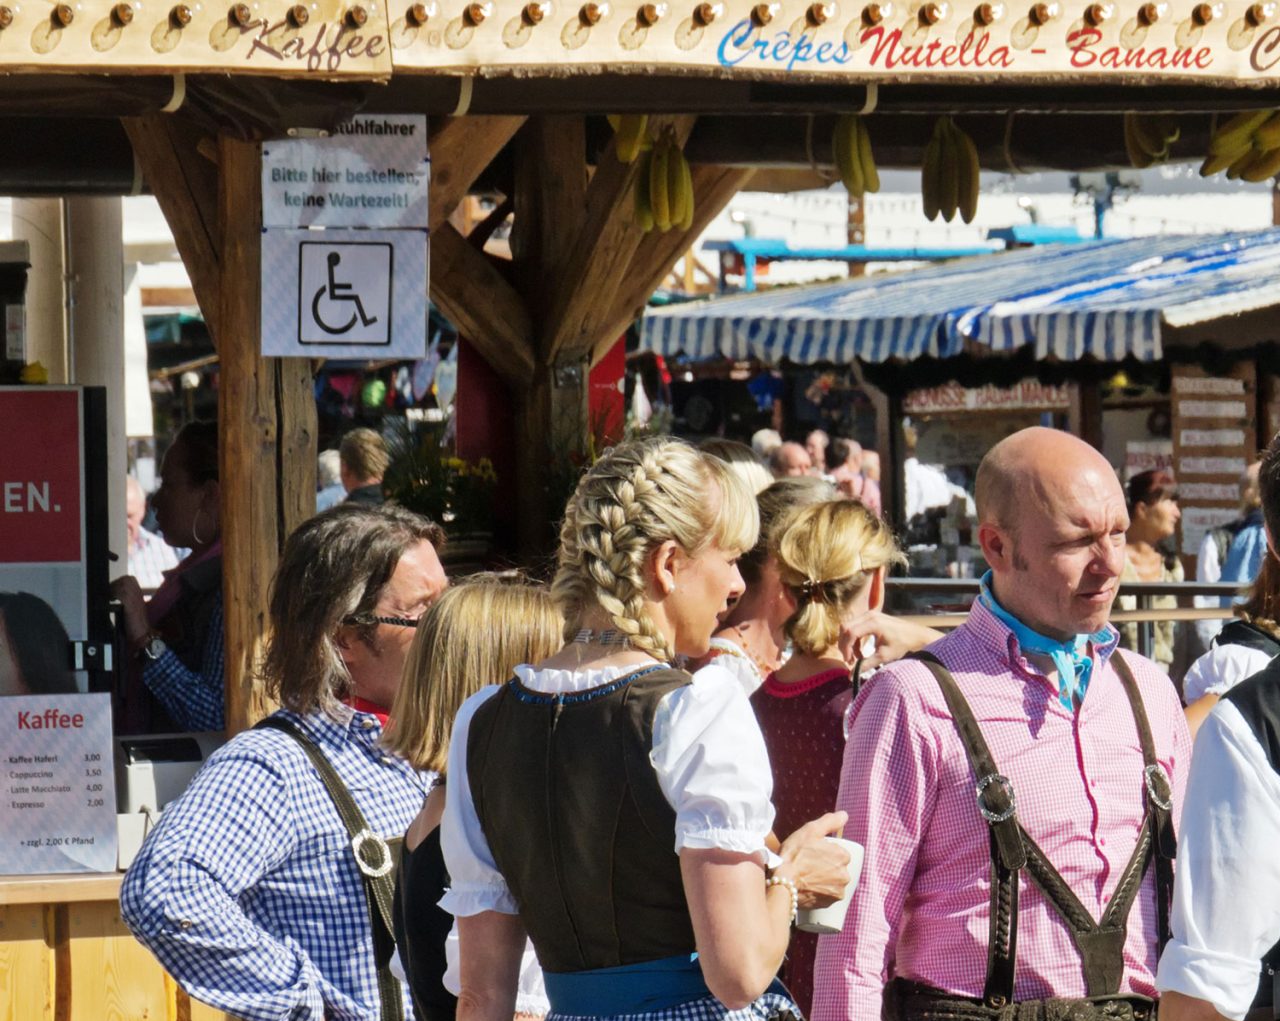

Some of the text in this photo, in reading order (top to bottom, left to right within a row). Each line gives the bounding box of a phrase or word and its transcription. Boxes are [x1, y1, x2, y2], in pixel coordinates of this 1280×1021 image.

[240, 19, 385, 72] Kaffee
[716, 19, 852, 71] Crêpes
[860, 26, 1014, 69] Nutella
[1066, 28, 1213, 69] Banane
[271, 167, 420, 186] Bitte hier bestellen,
[284, 190, 409, 209] keine Wartezeit!
[4, 481, 62, 513] EN.
[17, 708, 85, 730] Kaffee
[8, 753, 101, 764] Kaffee Haferl 3,00
[9, 770, 54, 779] Cappuccino
[10, 784, 103, 794] Latte Macchiato 4,00
[87, 798, 104, 808] 2,00
[46, 837, 63, 847] 2,00
[71, 836, 95, 846] Pfand
